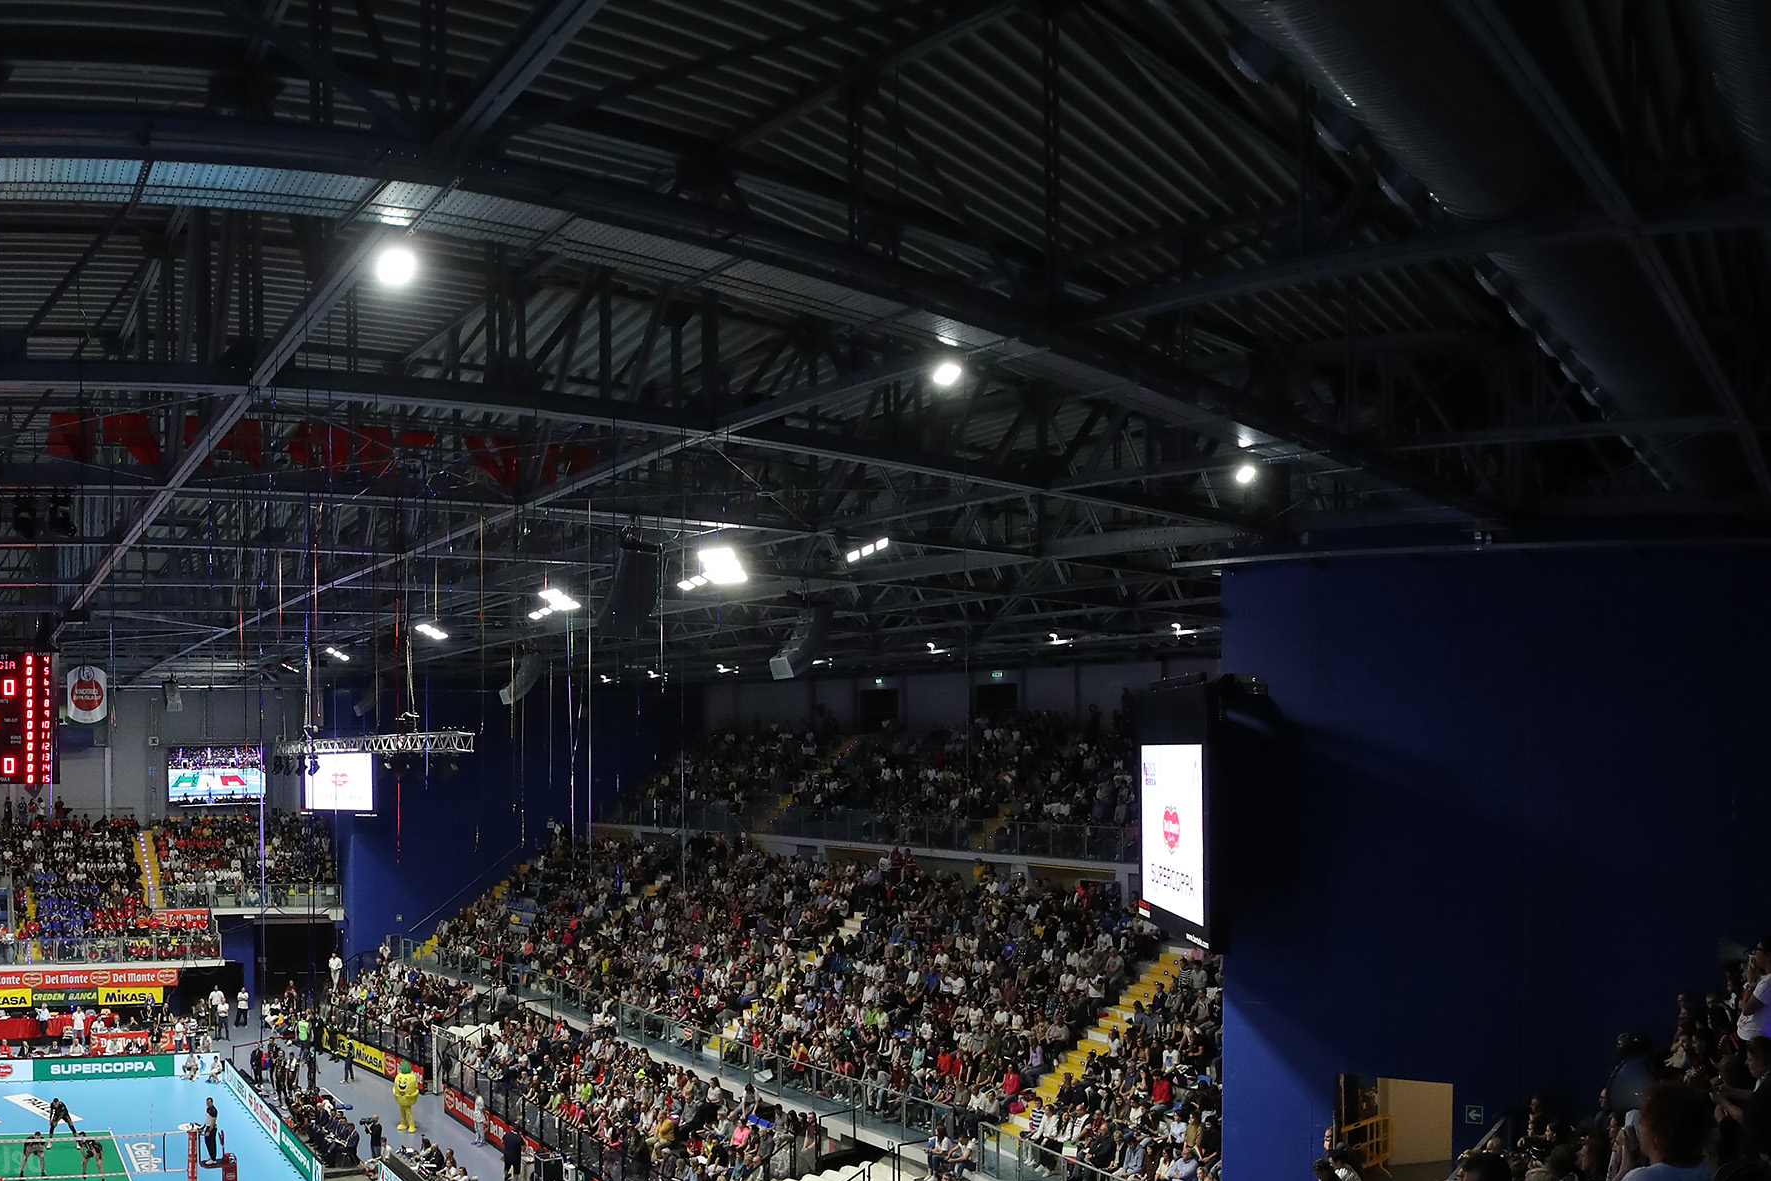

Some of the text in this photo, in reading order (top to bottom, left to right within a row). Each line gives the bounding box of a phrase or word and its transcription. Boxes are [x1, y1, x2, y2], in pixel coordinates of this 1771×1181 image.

[44, 667, 50, 675] 5
[3, 679, 15, 696] 0
[44, 678, 50, 686] 6
[44, 699, 50, 707] 8
[42, 742, 50, 750] 12
[3, 757, 15, 774] 0
[42, 764, 50, 772] 14
[1150, 861, 1195, 899] SUPERCOPPA
[45, 973, 88, 985] Del Monte
[112, 971, 156, 983] Del Monte
[32, 991, 97, 1001] CREDEM BANCA
[50, 1061, 156, 1075] SUPERCOPPA
